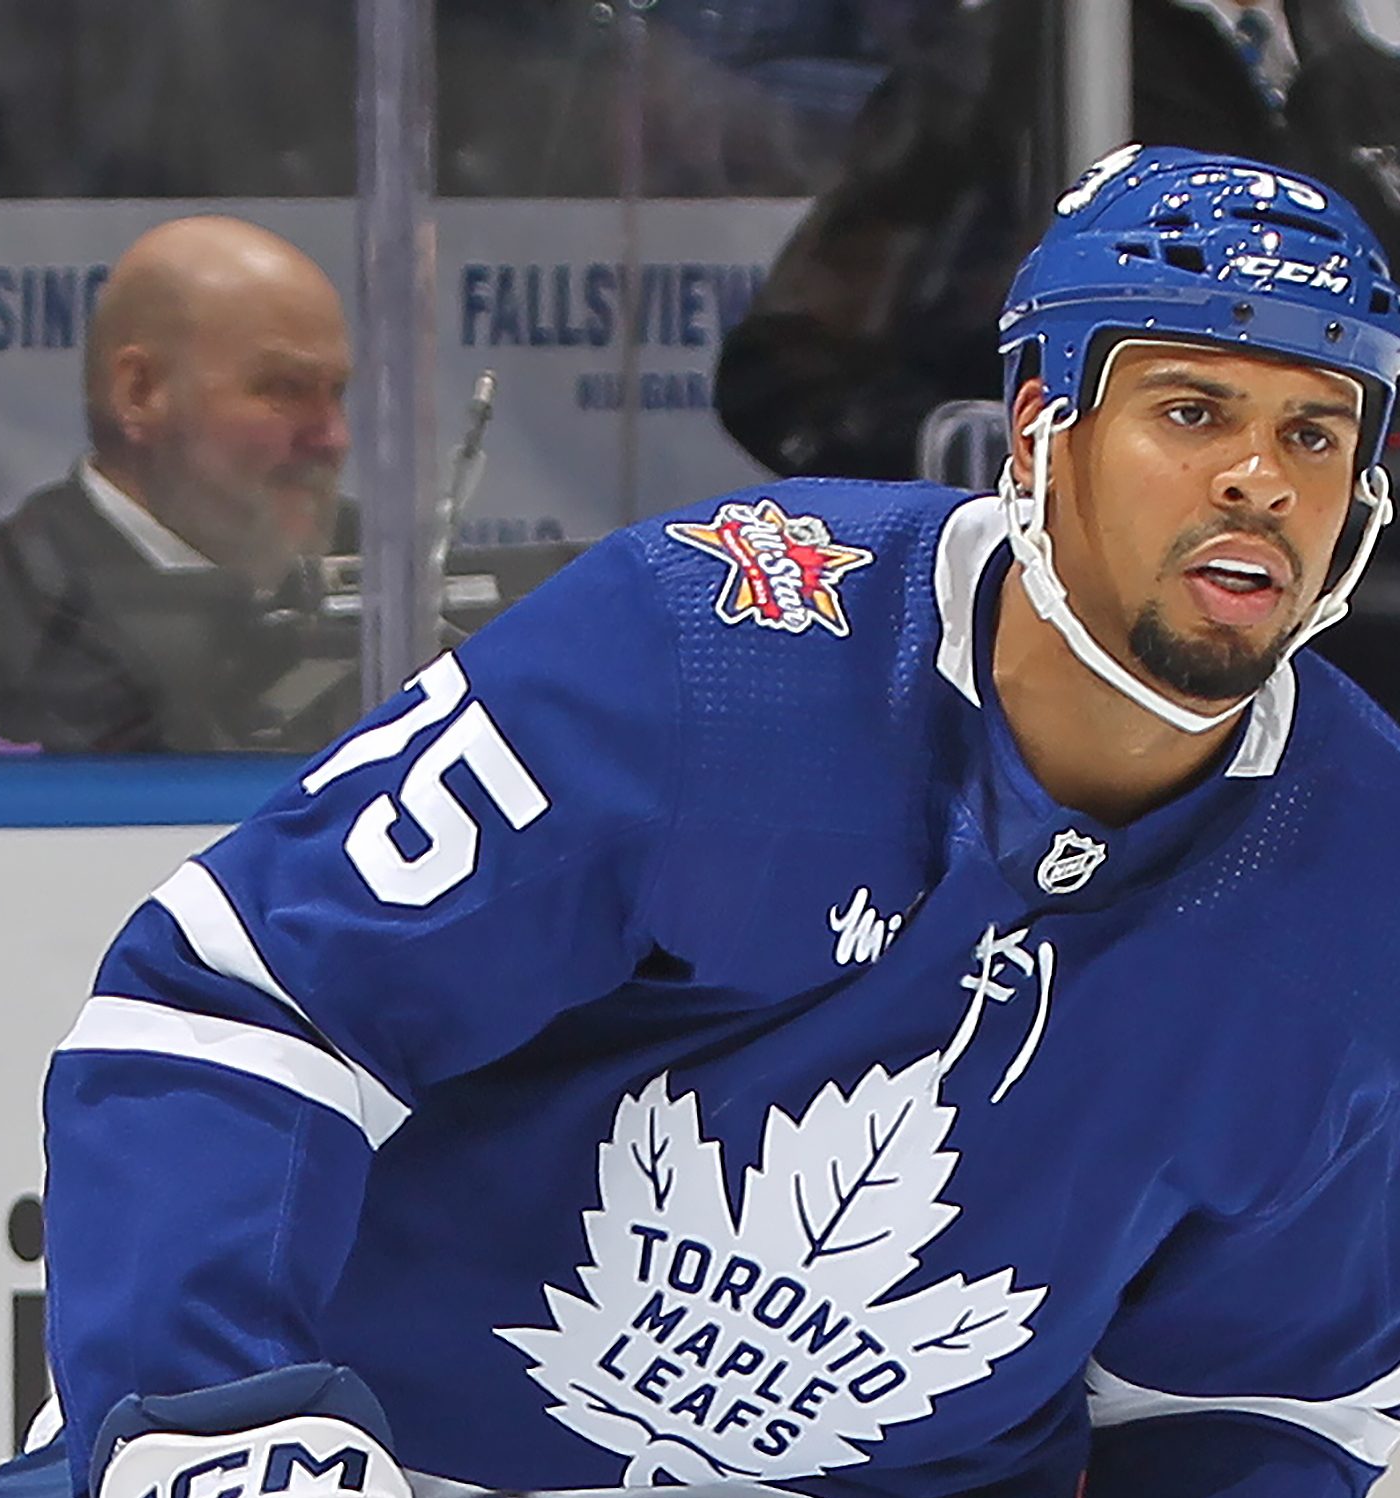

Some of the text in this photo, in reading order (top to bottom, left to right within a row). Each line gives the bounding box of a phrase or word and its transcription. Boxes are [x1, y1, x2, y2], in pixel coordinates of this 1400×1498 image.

[1242, 255, 1349, 294] CCM
[302, 650, 550, 907] 75
[630, 1224, 909, 1404] TORONTO
[633, 1291, 837, 1420] MAPLE
[599, 1334, 800, 1458] LEAFS
